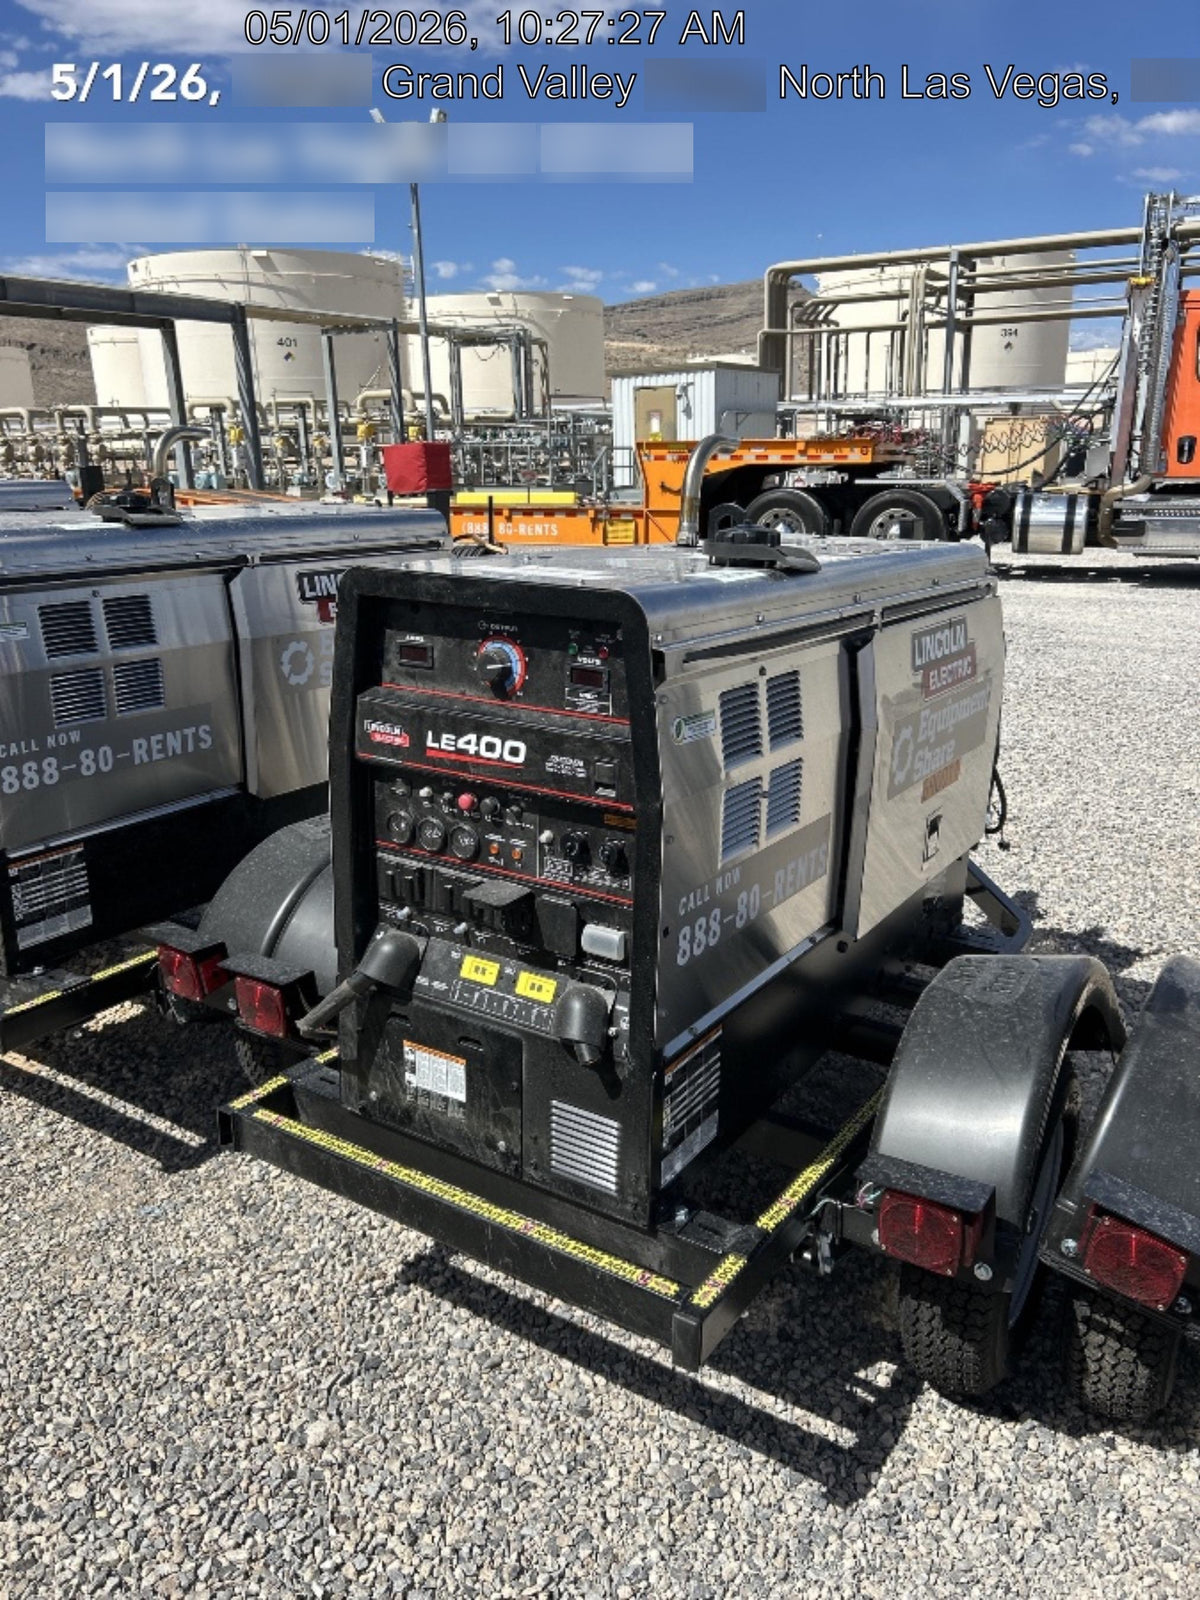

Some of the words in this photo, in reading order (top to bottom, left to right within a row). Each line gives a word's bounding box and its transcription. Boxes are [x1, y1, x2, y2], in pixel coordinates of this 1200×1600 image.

[276, 336, 298, 348] 401
[914, 623, 967, 667] LINCOLN
[928, 654, 973, 692] ELECTRIC
[0, 739, 39, 758] CALL
[47, 730, 81, 748] NOW
[1, 724, 213, 795] 888-80-RENTS
[426, 730, 527, 764] LE400
[676, 841, 829, 967] 888-80-RENTS
[678, 884, 711, 916] CALL
[715, 866, 742, 895] NOW
